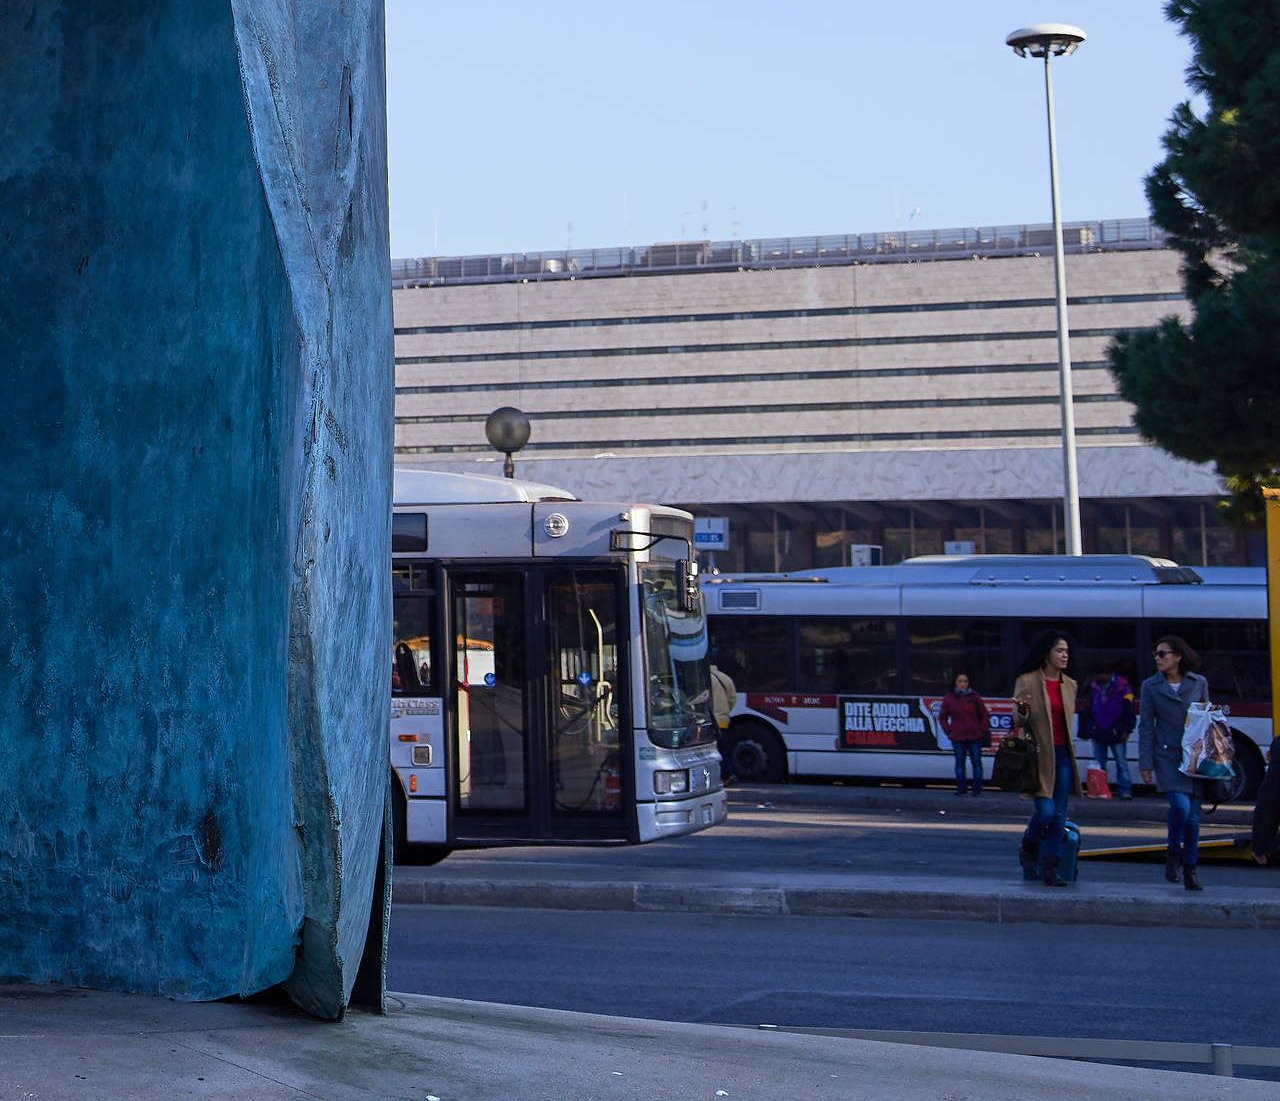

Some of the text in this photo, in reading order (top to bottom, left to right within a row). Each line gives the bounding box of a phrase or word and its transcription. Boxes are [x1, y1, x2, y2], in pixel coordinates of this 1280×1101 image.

[845, 702, 910, 718] DITE ADDIO
[845, 716, 926, 732] ALLA VECCHIA
